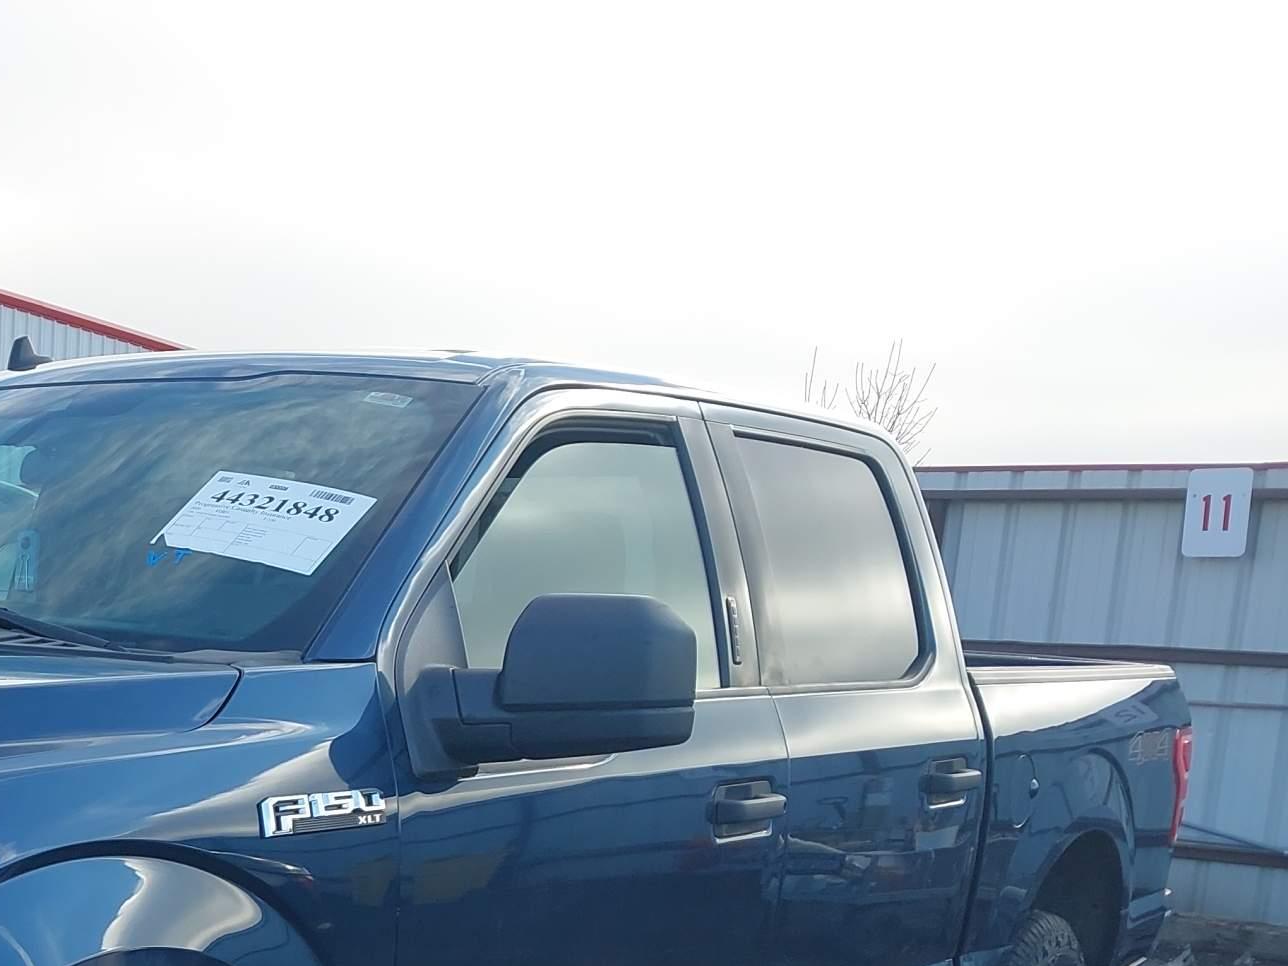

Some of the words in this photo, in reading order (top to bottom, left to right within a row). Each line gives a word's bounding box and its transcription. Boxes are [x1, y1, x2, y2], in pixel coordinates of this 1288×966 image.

[210, 489, 340, 523] 44321848
[1202, 494, 1232, 531] 11
[357, 813, 382, 825] XLT
